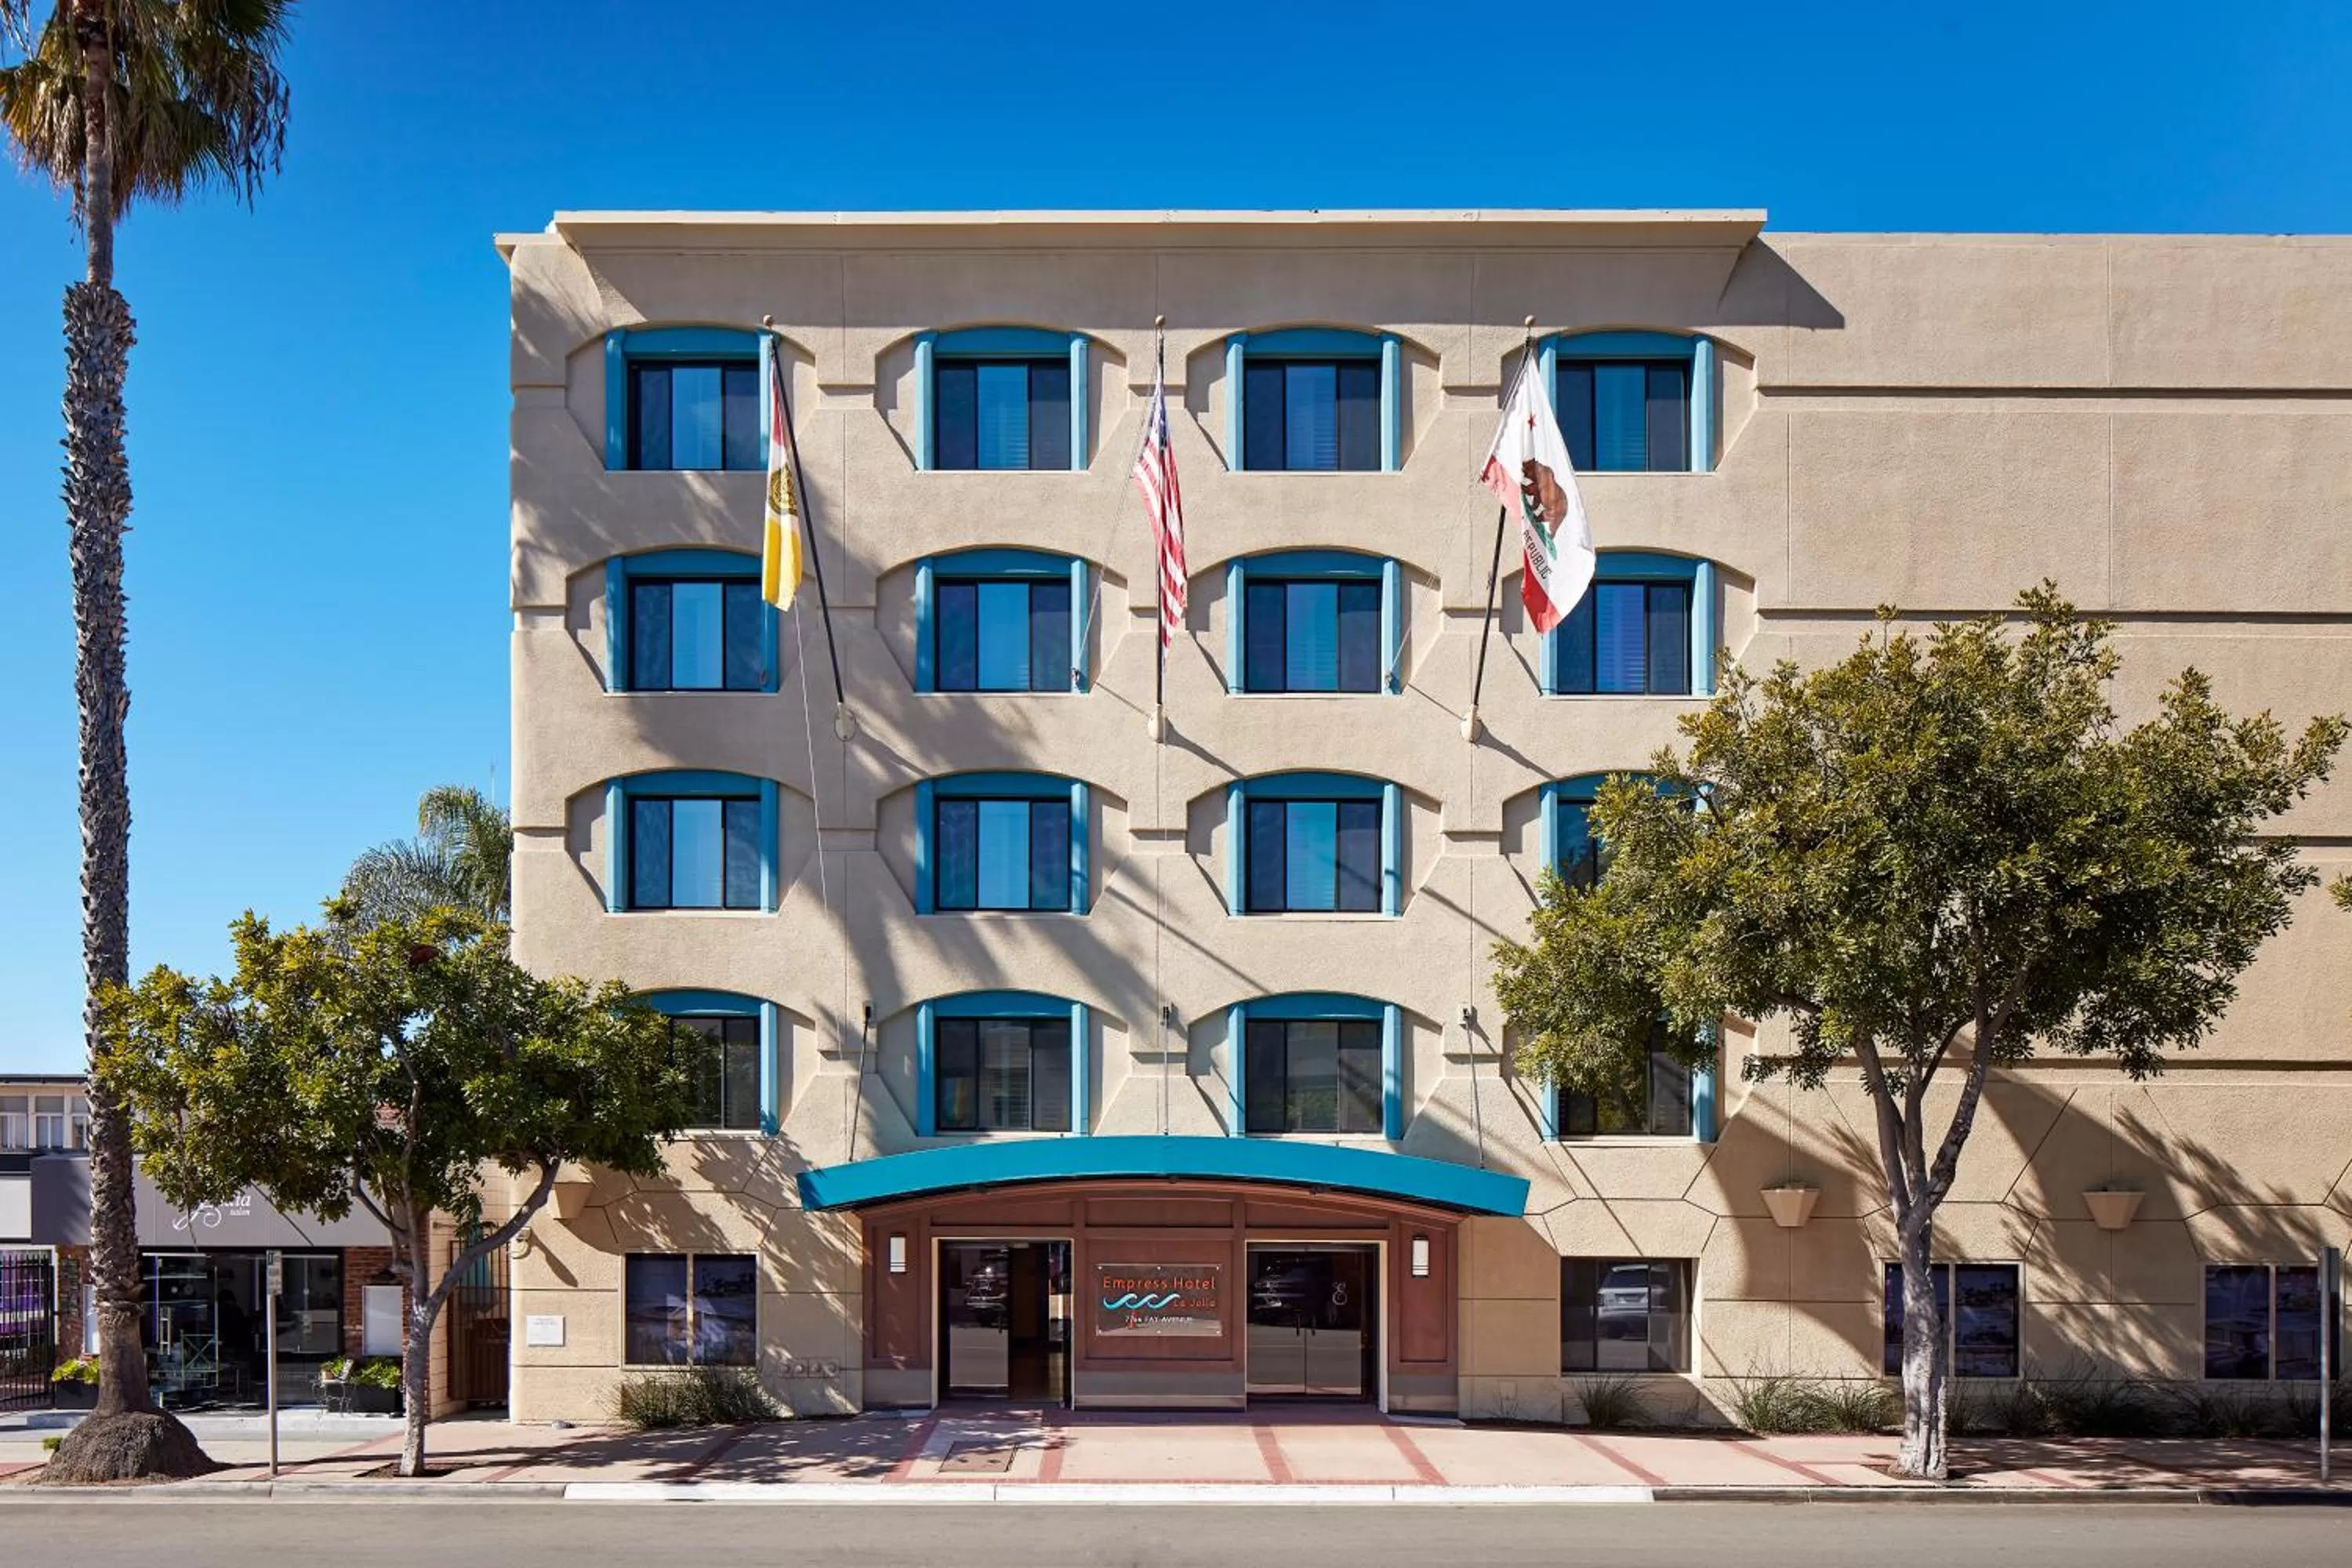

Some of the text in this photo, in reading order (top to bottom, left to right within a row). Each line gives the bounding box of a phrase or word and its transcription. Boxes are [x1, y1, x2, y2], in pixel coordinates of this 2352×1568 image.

[1523, 529, 1552, 579] REPUBLIC
[1102, 1276, 1216, 1291] Empress Hotel
[1173, 1298, 1216, 1308] La Jolla
